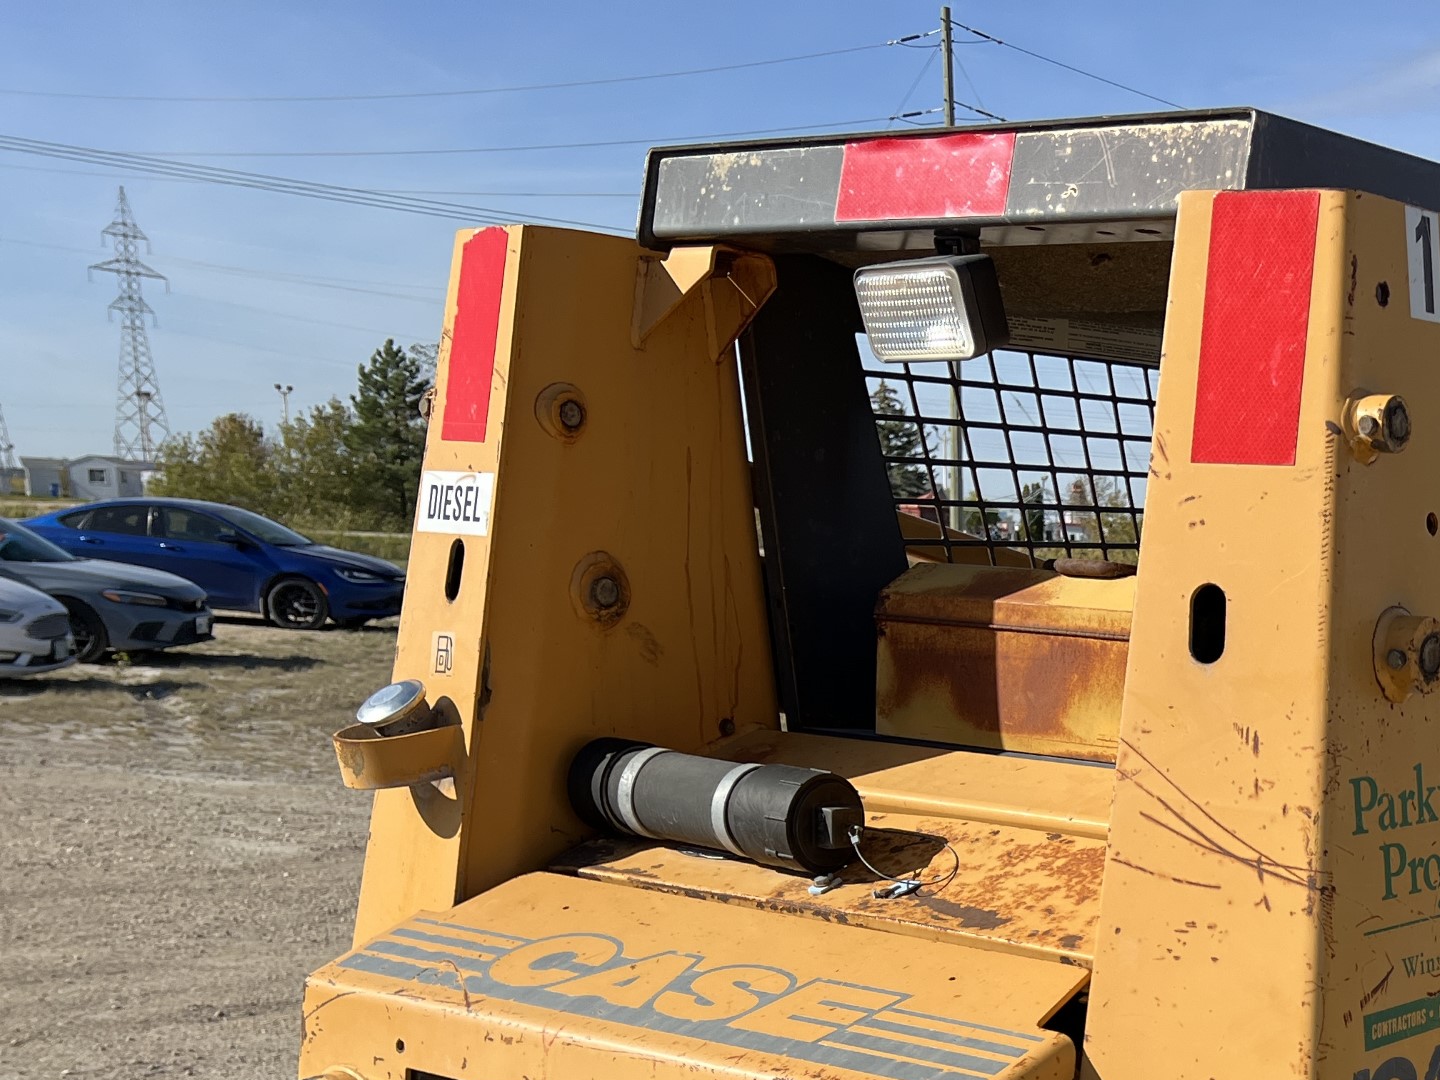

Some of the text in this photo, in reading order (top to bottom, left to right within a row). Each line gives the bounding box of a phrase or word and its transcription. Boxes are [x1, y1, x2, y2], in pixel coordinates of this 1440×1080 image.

[1415, 215, 1435, 314] 1
[427, 484, 481, 522] DIESEL
[487, 932, 910, 1043] CASE
[1371, 1008, 1427, 1041] CONTRACTORS
